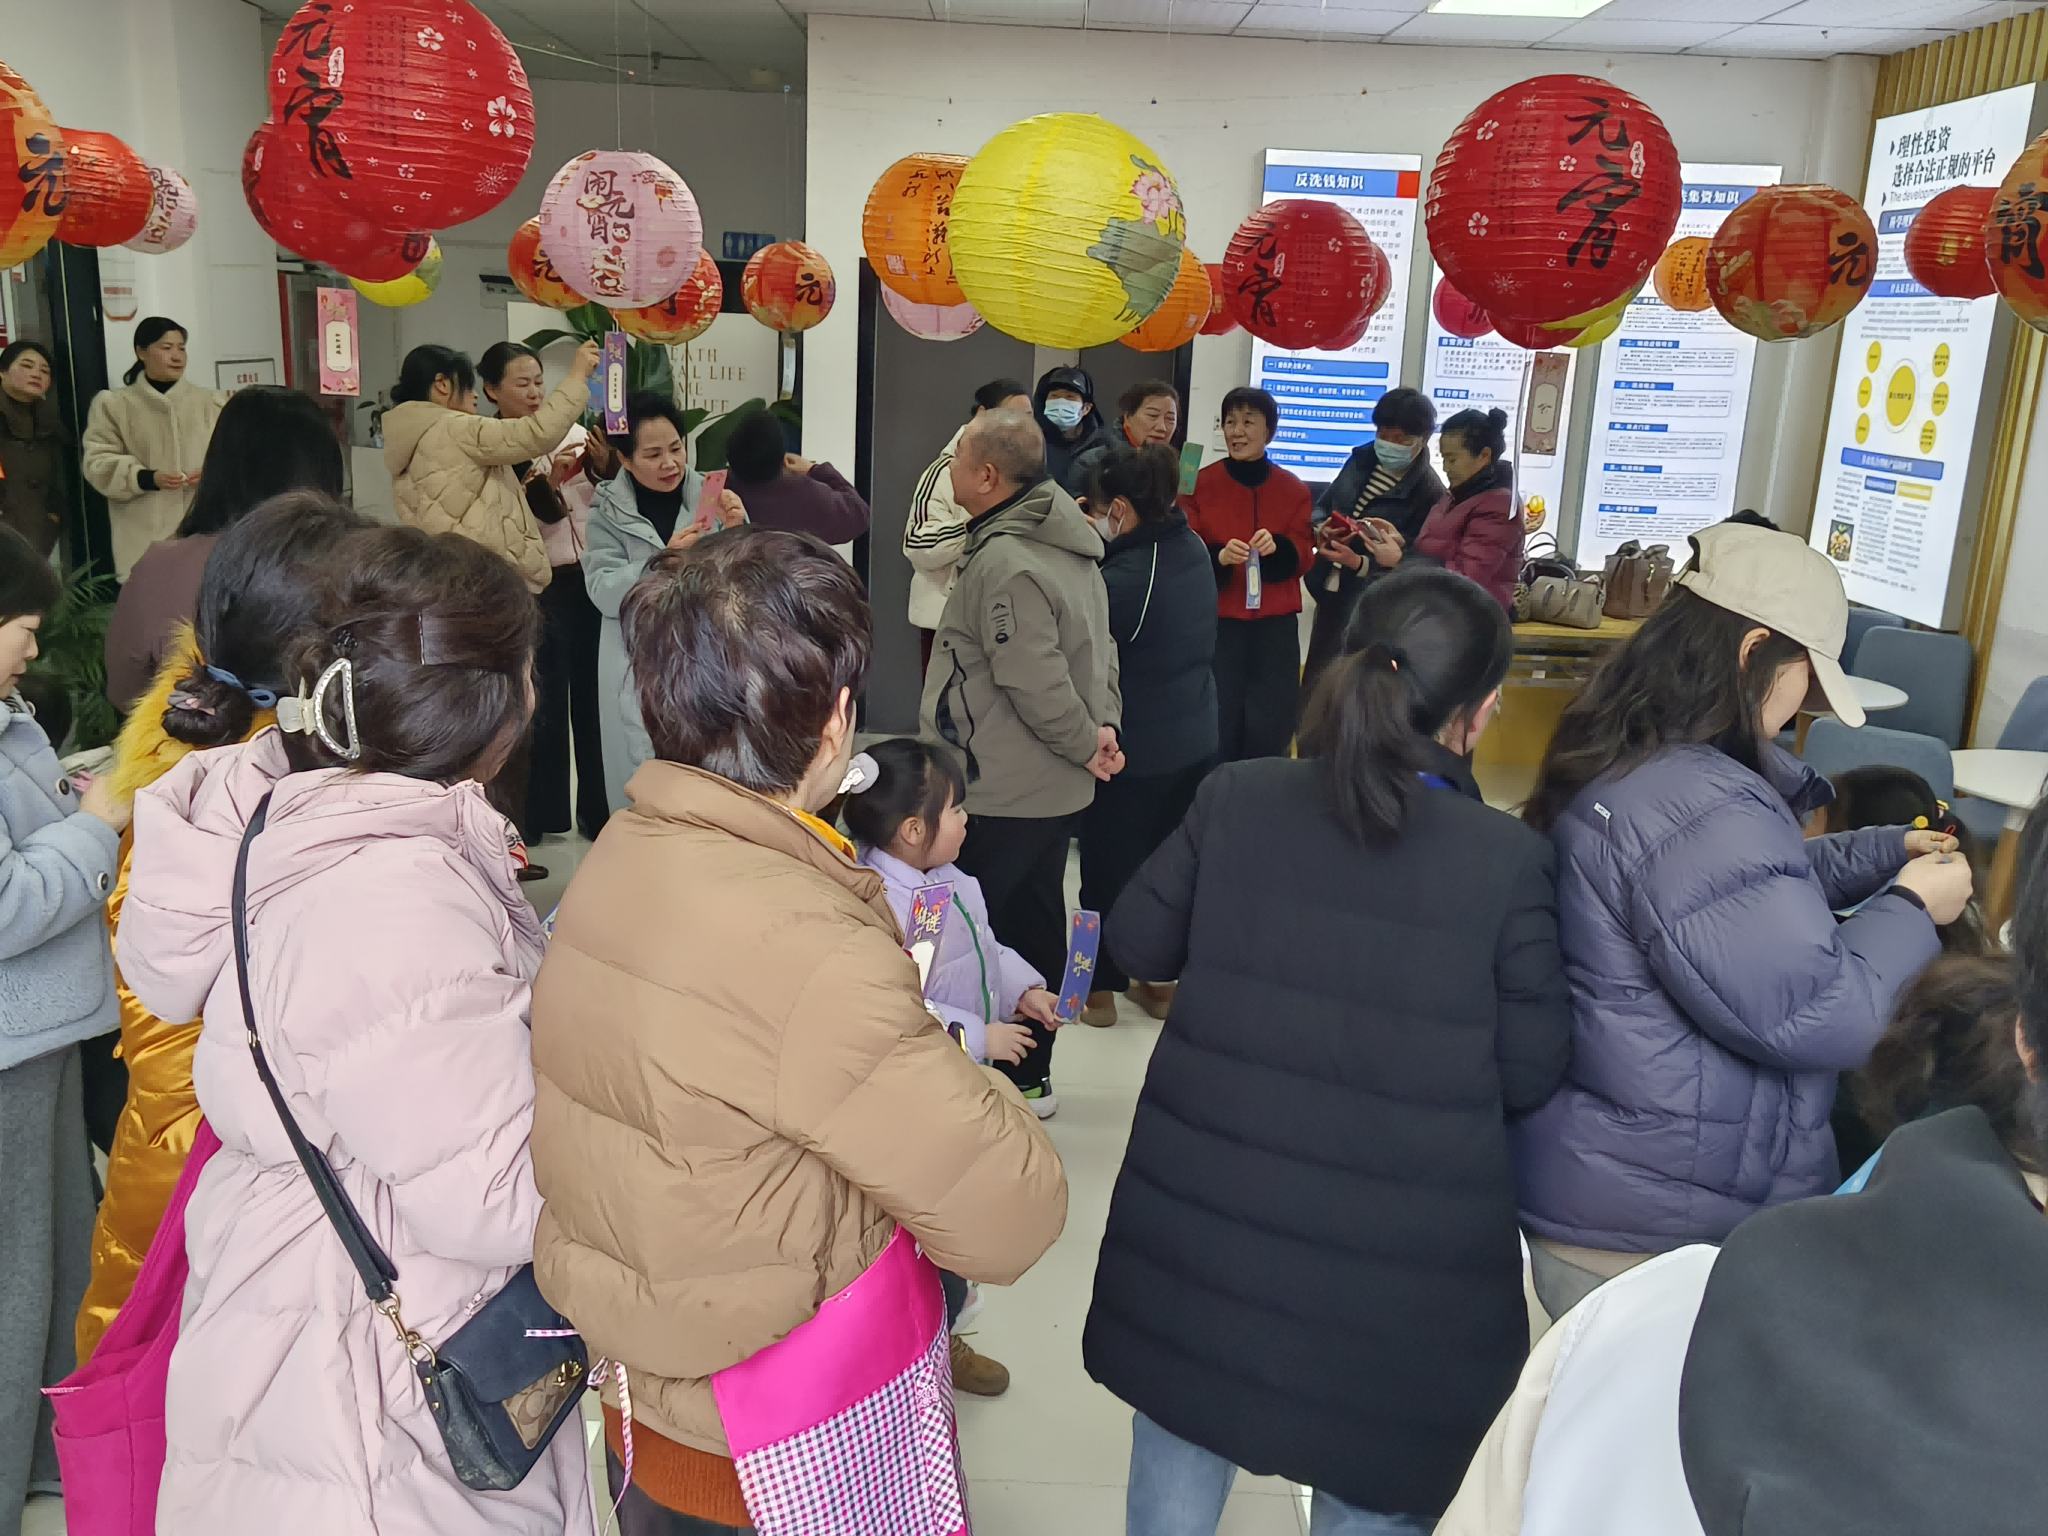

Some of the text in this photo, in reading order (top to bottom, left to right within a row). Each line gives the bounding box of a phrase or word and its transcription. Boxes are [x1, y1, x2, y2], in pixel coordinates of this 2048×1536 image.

[282, 3, 353, 180] 元宵
[1897, 125, 1952, 158] 理性投资
[18, 132, 67, 217] 元
[1295, 172, 1364, 189] 反洗钱知识
[1556, 96, 1642, 268] 元宵
[1892, 147, 1996, 187] 选择合法正规的平台
[1238, 222, 1282, 327] 元宵
[1827, 232, 1869, 286] 元
[795, 273, 823, 306] 元
[710, 366, 746, 381] LIFE
